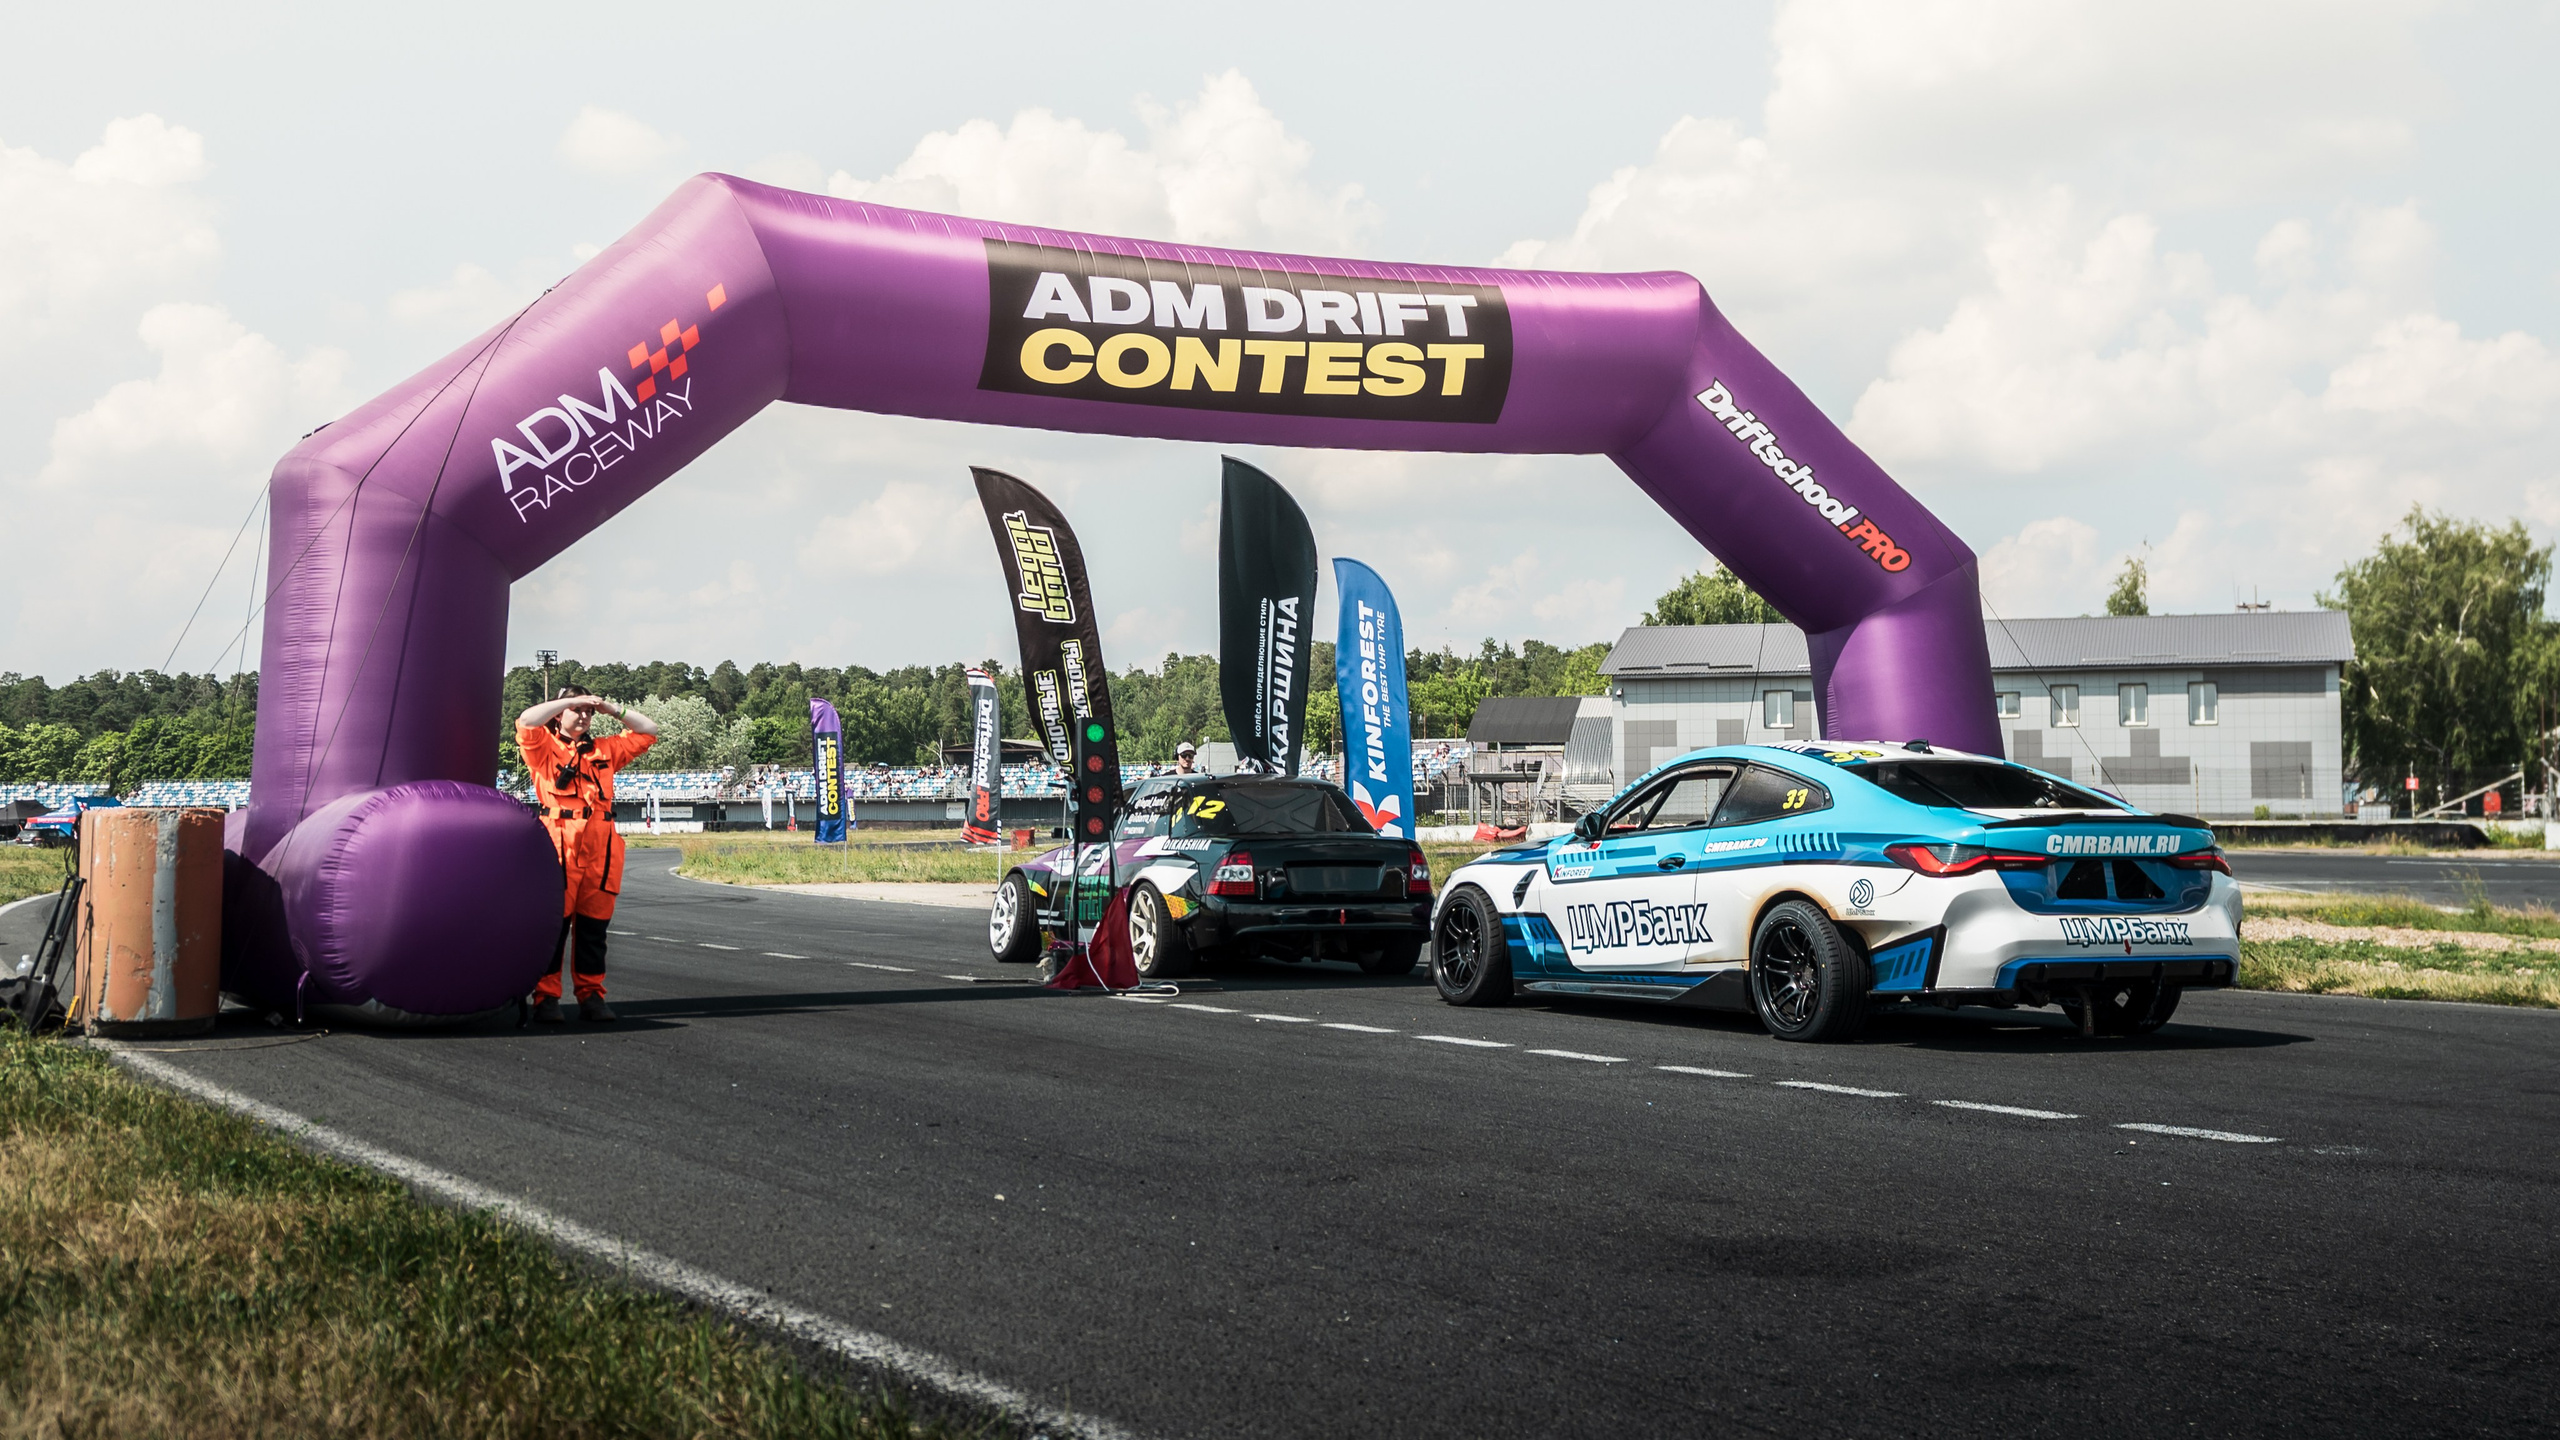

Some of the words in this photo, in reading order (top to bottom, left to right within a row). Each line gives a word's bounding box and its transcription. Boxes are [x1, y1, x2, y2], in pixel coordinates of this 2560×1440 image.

[1022, 271, 1227, 331] ADM
[1242, 286, 1478, 337] DRIFT
[1020, 328, 1485, 397] CONTEST
[490, 366, 638, 494] ADM
[510, 377, 693, 523] RACEWAY
[1376, 611, 1385, 641] TYRE
[1254, 702, 1262, 738] КОЛЁСА
[1260, 597, 1268, 626] СТИЛЬ
[1378, 643, 1386, 670] UHP
[1063, 641, 1090, 720] УЛЯТОРЫ
[1357, 600, 1388, 783] KINFOREST
[1380, 671, 1391, 703] BEST
[1382, 704, 1392, 728] THE
[817, 738, 827, 781] DRIFT
[826, 736, 839, 815] CONTEST
[820, 781, 828, 816] ADM
[1187, 796, 1226, 819] 12
[1782, 788, 1809, 810] 33
[1704, 837, 1769, 854] CMRBANK.RU
[2046, 834, 2181, 854] CMRBANK.RU
[1567, 899, 1714, 954] ЦМРБанк
[2059, 917, 2194, 949] ЦМРБанк
